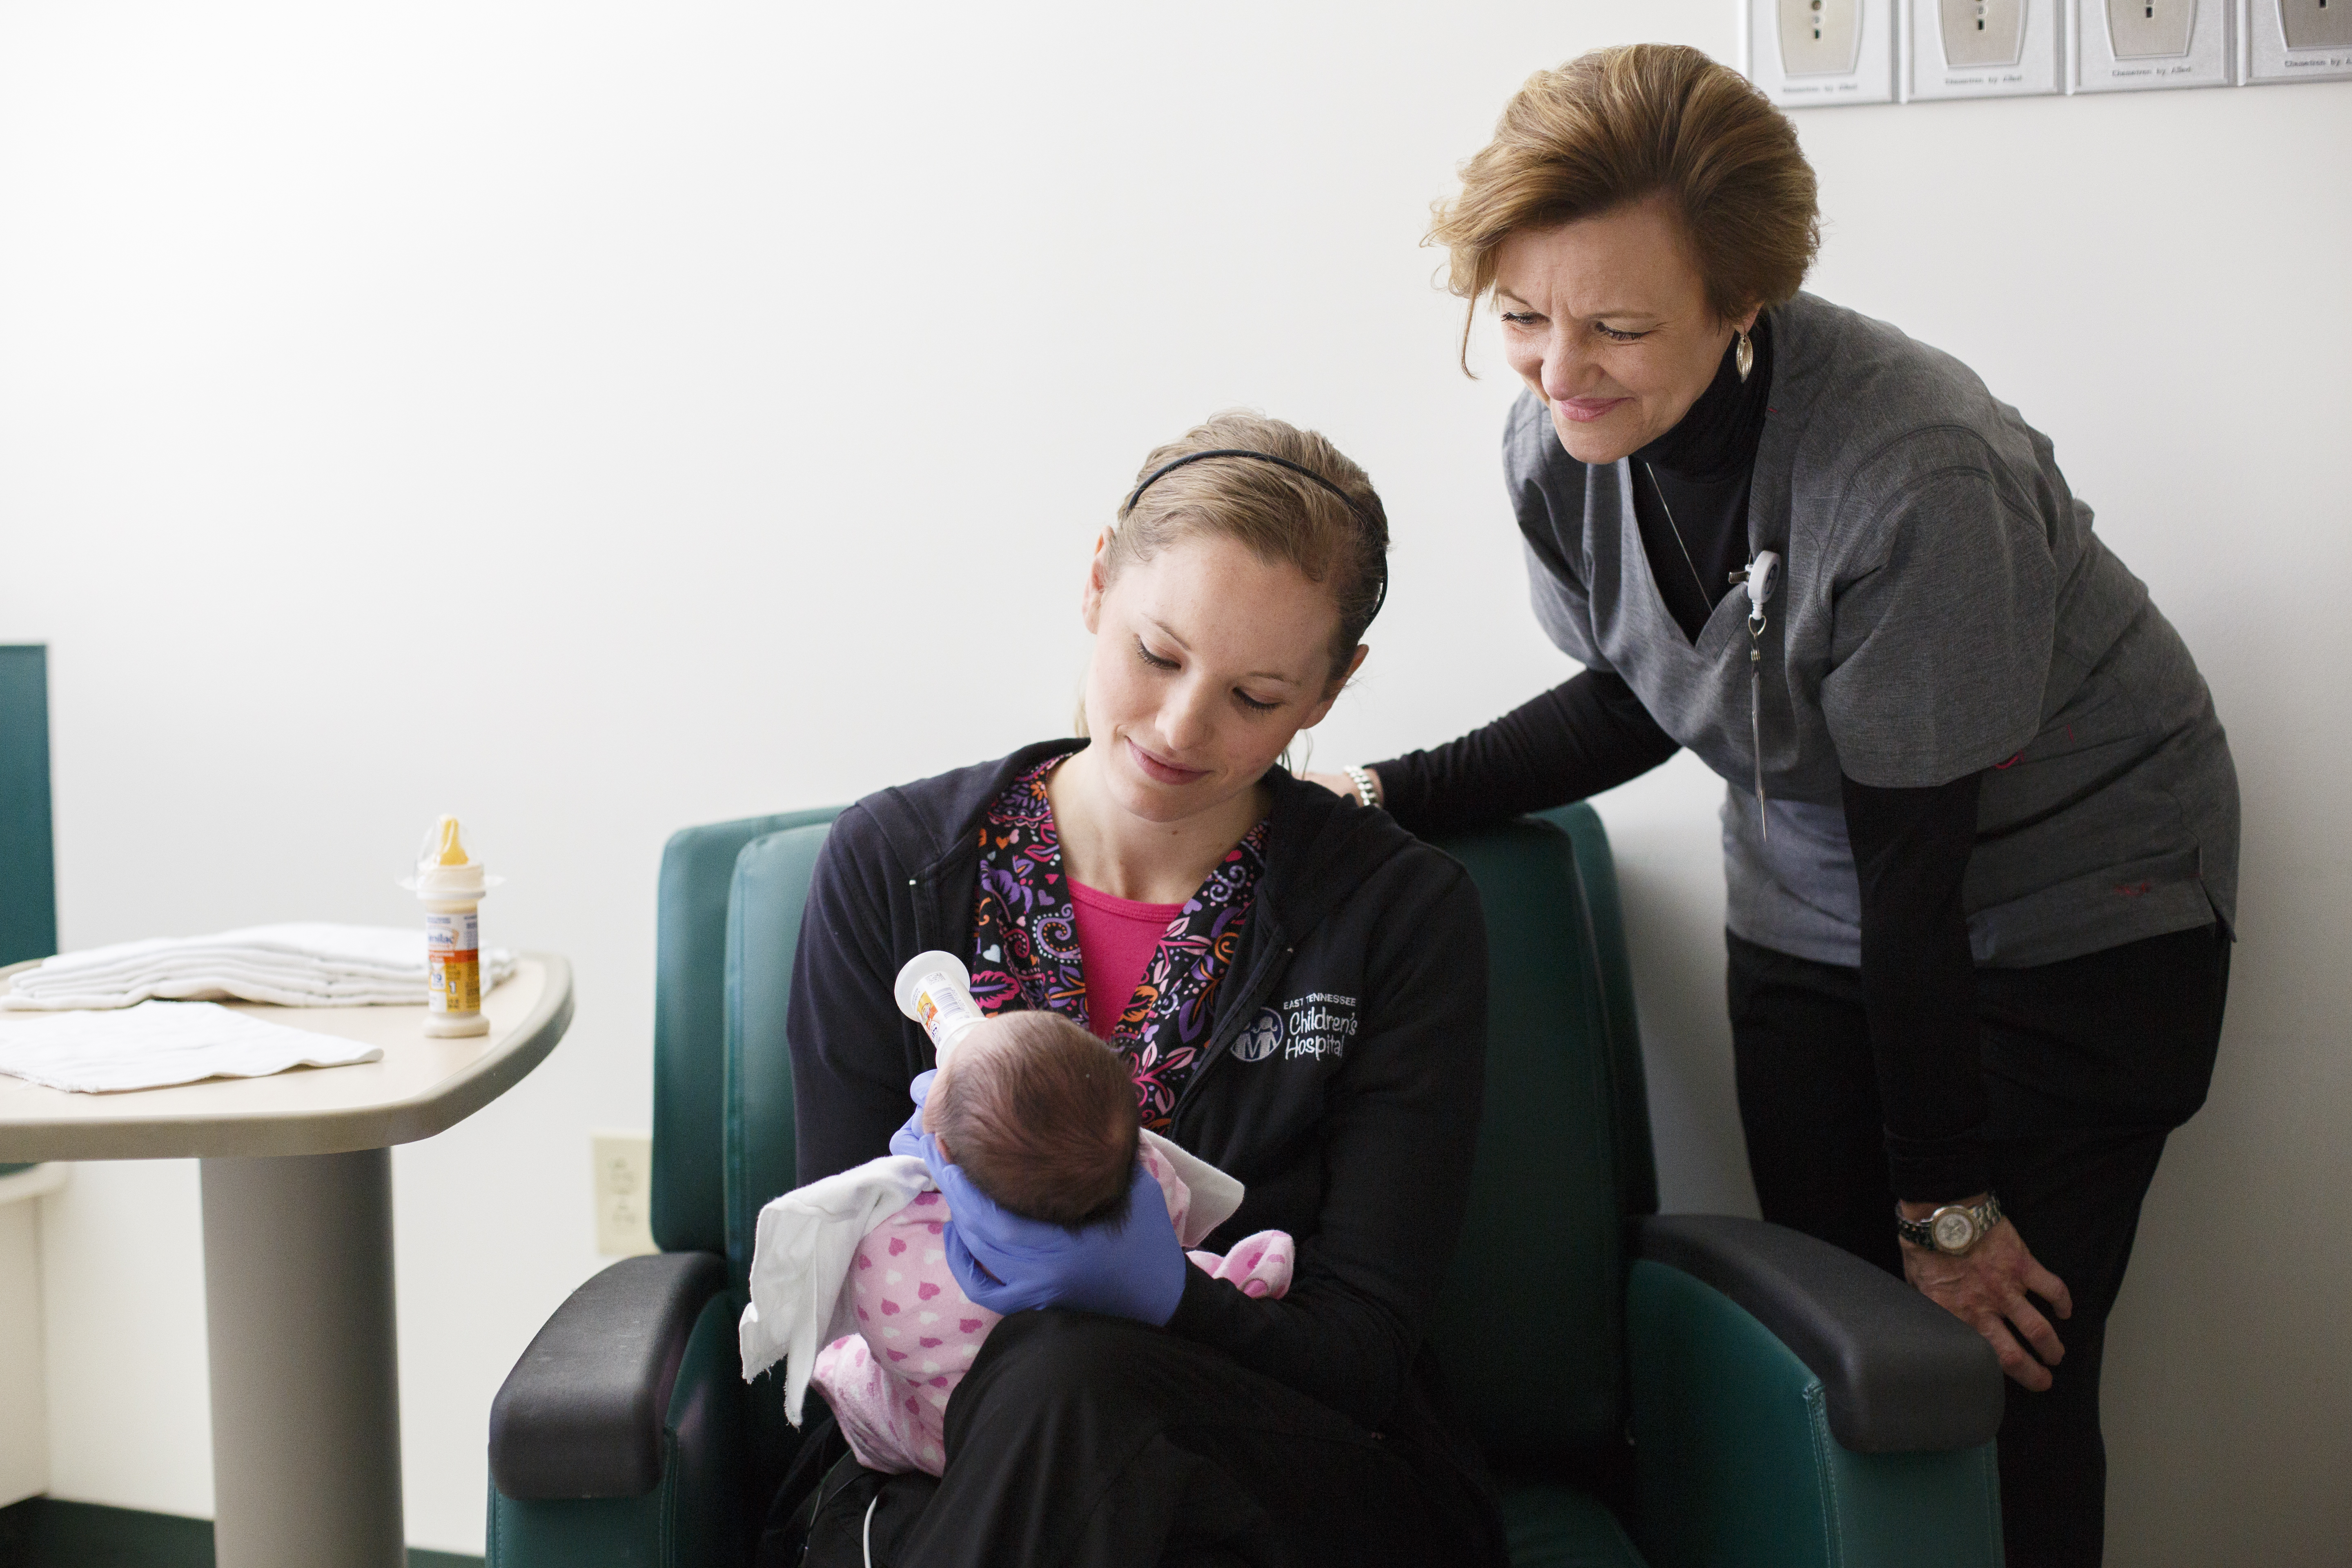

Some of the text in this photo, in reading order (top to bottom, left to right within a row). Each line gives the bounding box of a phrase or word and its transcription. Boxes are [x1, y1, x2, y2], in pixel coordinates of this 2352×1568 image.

[428, 933, 453, 944] imilac
[1283, 993, 1356, 1010] EAST TENNESSEE
[1290, 1006, 1358, 1035] Children's
[1285, 1034, 1345, 1061] Hospital
